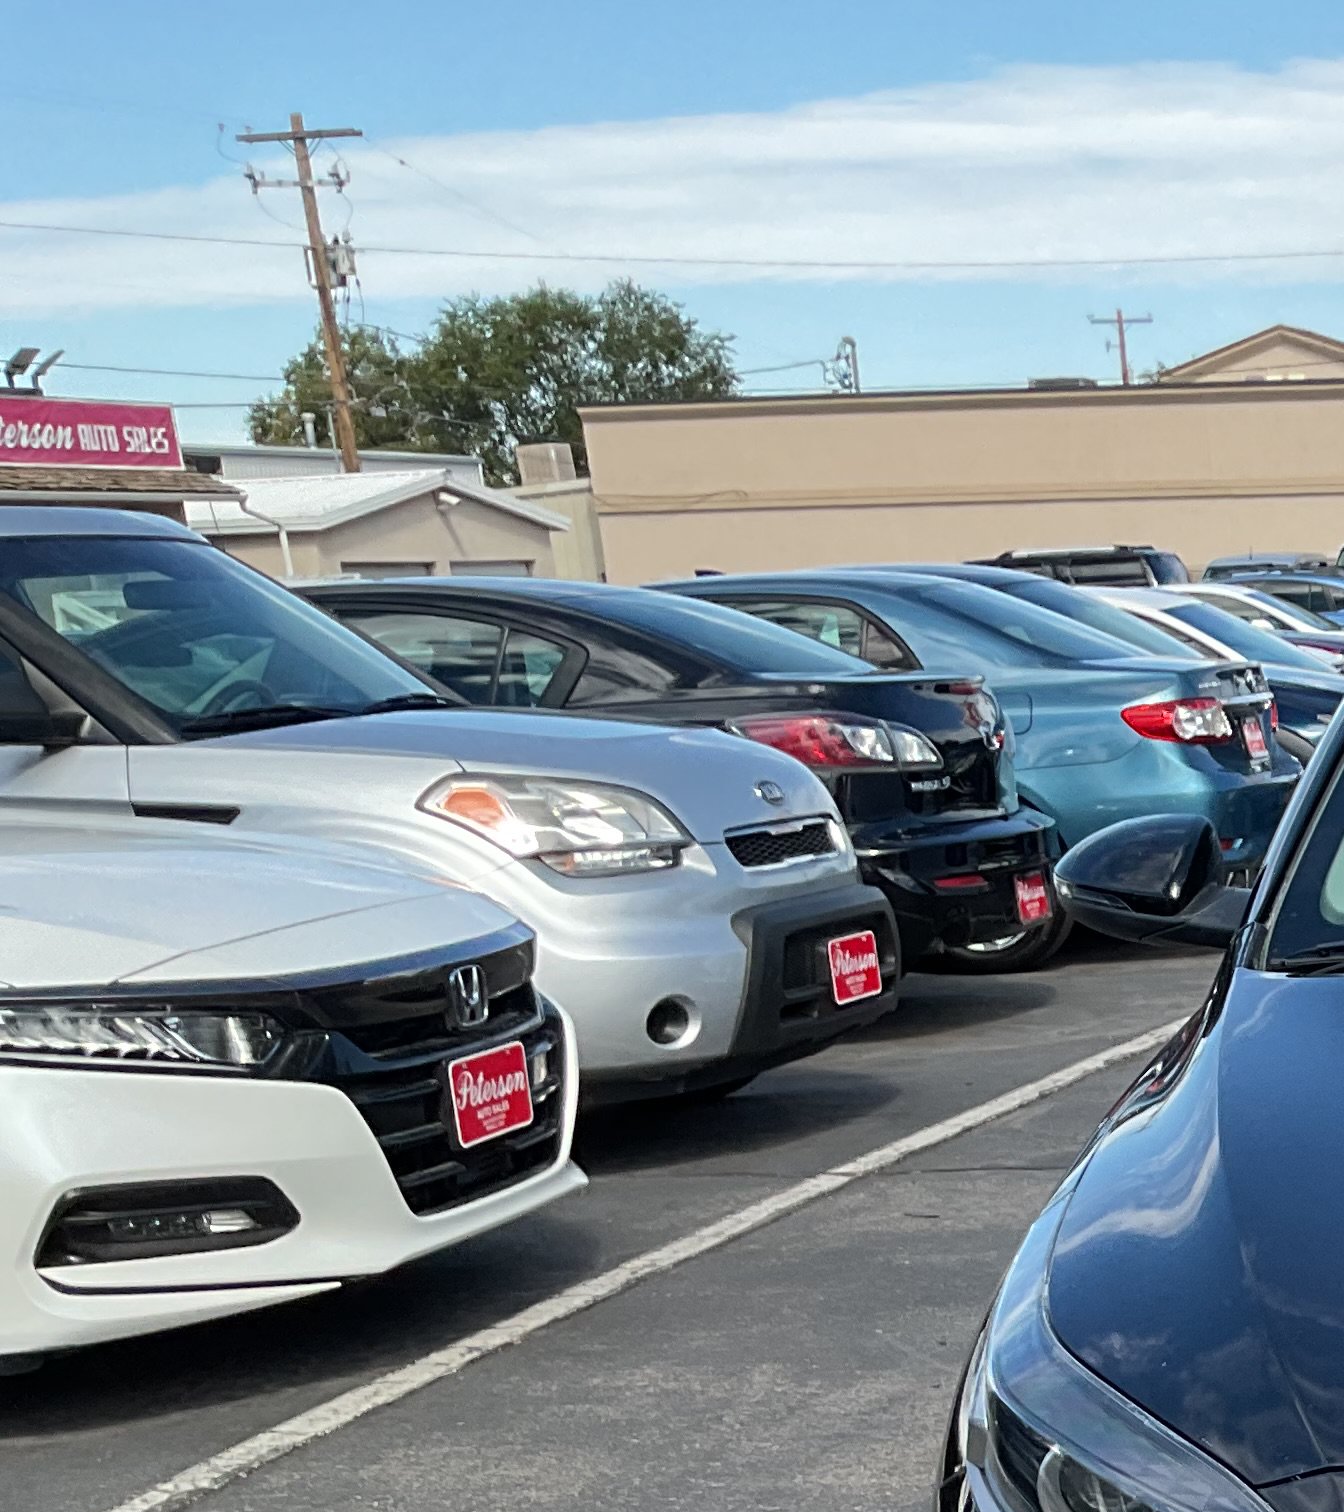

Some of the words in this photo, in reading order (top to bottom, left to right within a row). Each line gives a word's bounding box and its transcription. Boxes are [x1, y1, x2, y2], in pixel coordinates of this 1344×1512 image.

[77, 423, 120, 452] AUTO
[122, 425, 170, 454] SALES
[456, 1070, 526, 1111] Peterson
